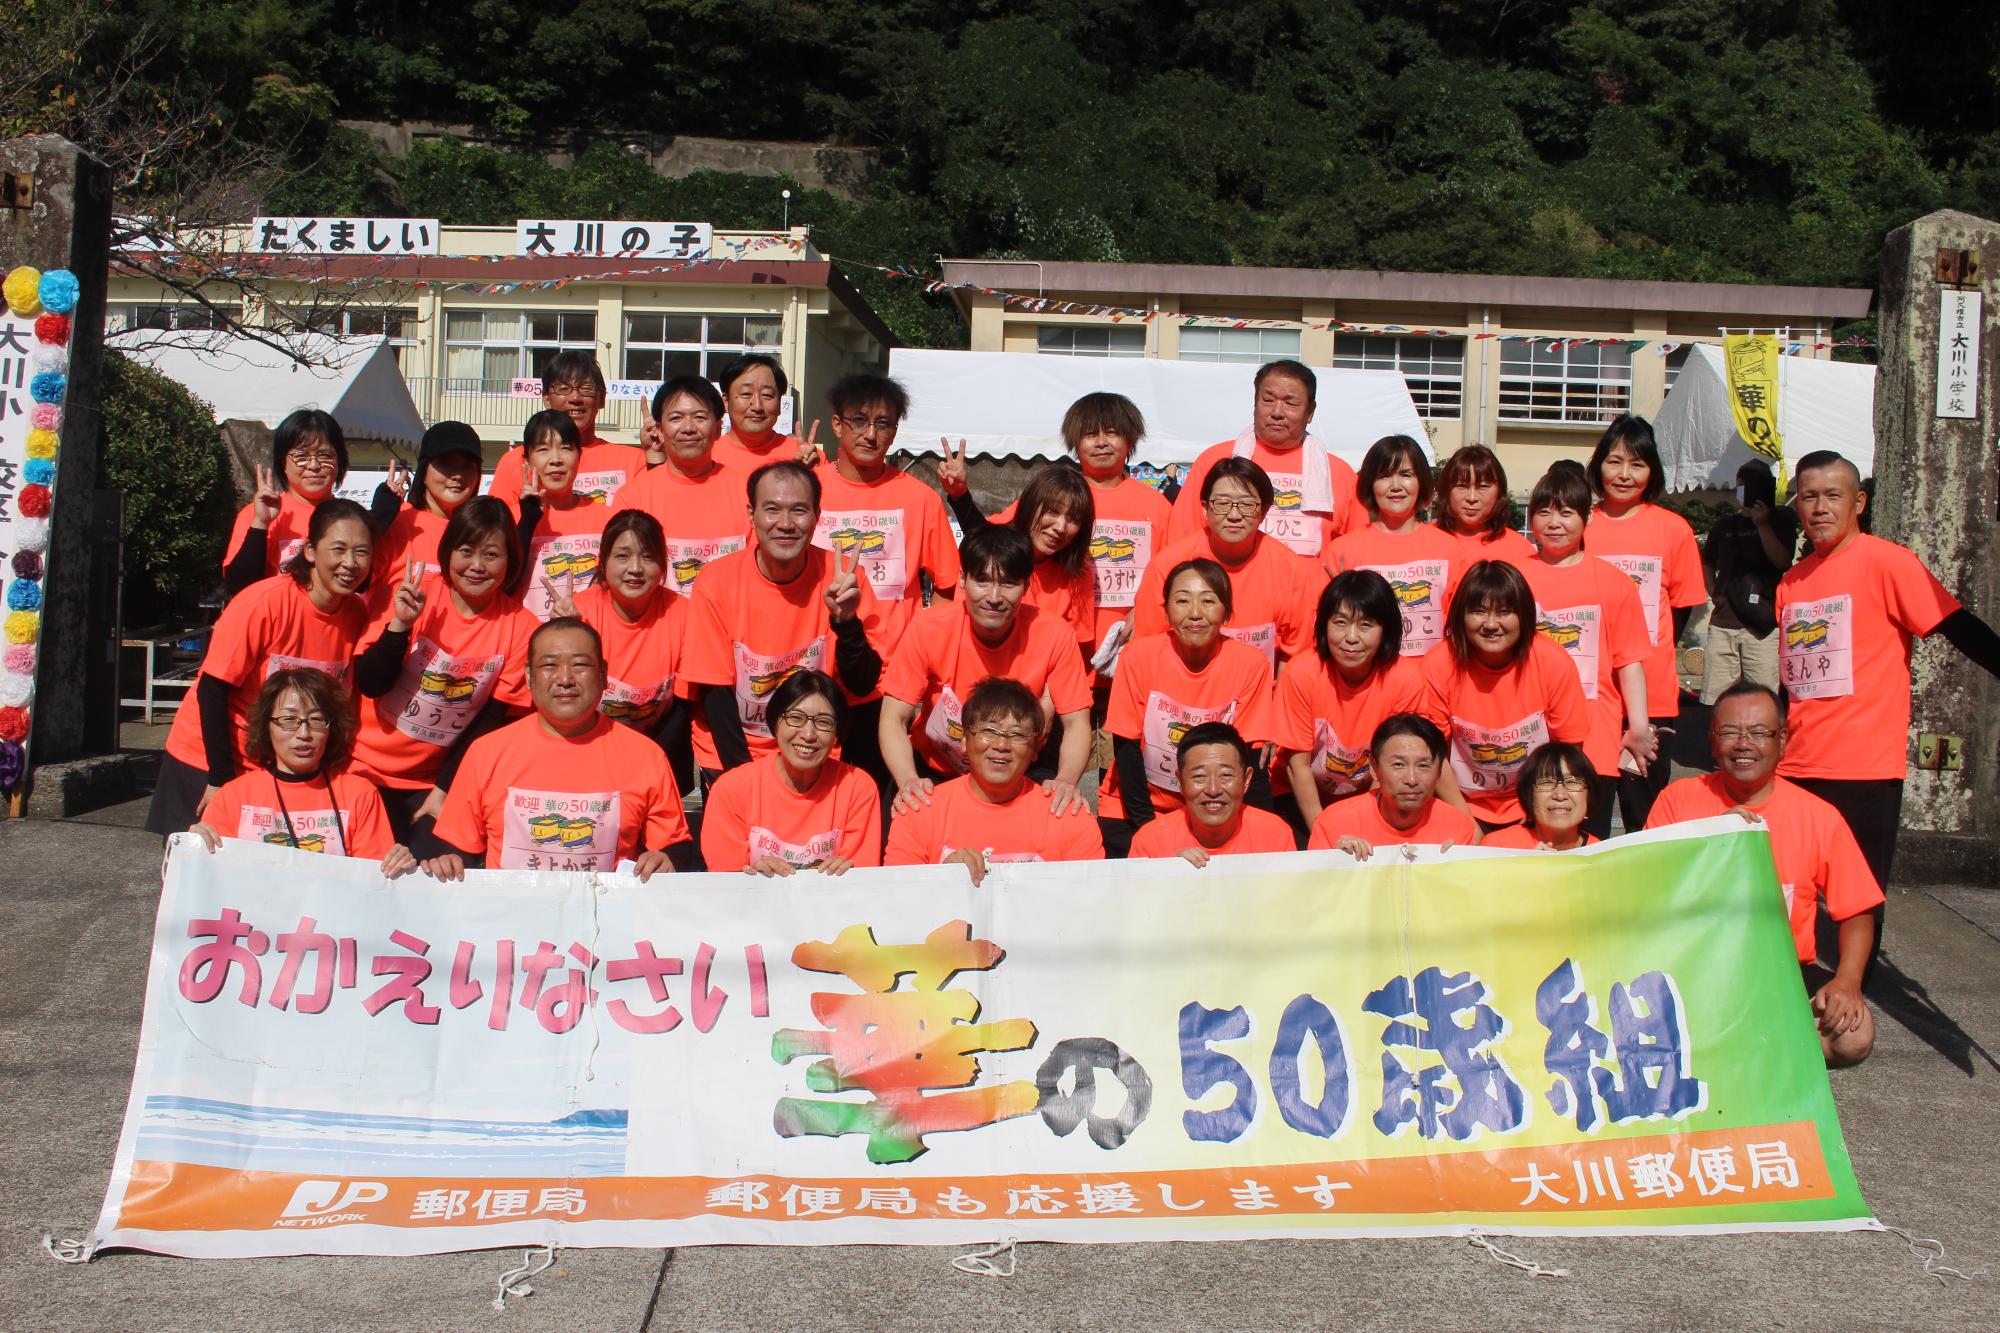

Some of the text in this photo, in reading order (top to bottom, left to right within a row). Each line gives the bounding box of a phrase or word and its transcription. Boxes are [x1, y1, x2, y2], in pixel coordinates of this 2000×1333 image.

[261, 220, 701, 256] たくましい 大川の子
[1947, 332, 1969, 413] 大川小学校
[841, 516, 898, 527] 華の50歳組
[683, 543, 739, 557] 華の50歳組
[1387, 565, 1442, 579] 華の50歳組
[1794, 602, 1844, 618] 華の50歳組
[404, 699, 466, 730] ゆうこ
[1157, 700, 1179, 717] 歓迎
[1481, 720, 1540, 743] 華の50歳組
[513, 794, 612, 813] 歓迎 華の50歳組
[252, 812, 272, 827] 歓迎
[757, 834, 780, 855] 歓迎
[178, 907, 1709, 1166] おかえりなさい 華の50歳組
[410, 1188, 587, 1220] 郵便局
[706, 1173, 1352, 1214] 郵便局も応援します
[1511, 1140, 1800, 1206] 大川郵便局
[272, 1213, 368, 1228] NETWORK
